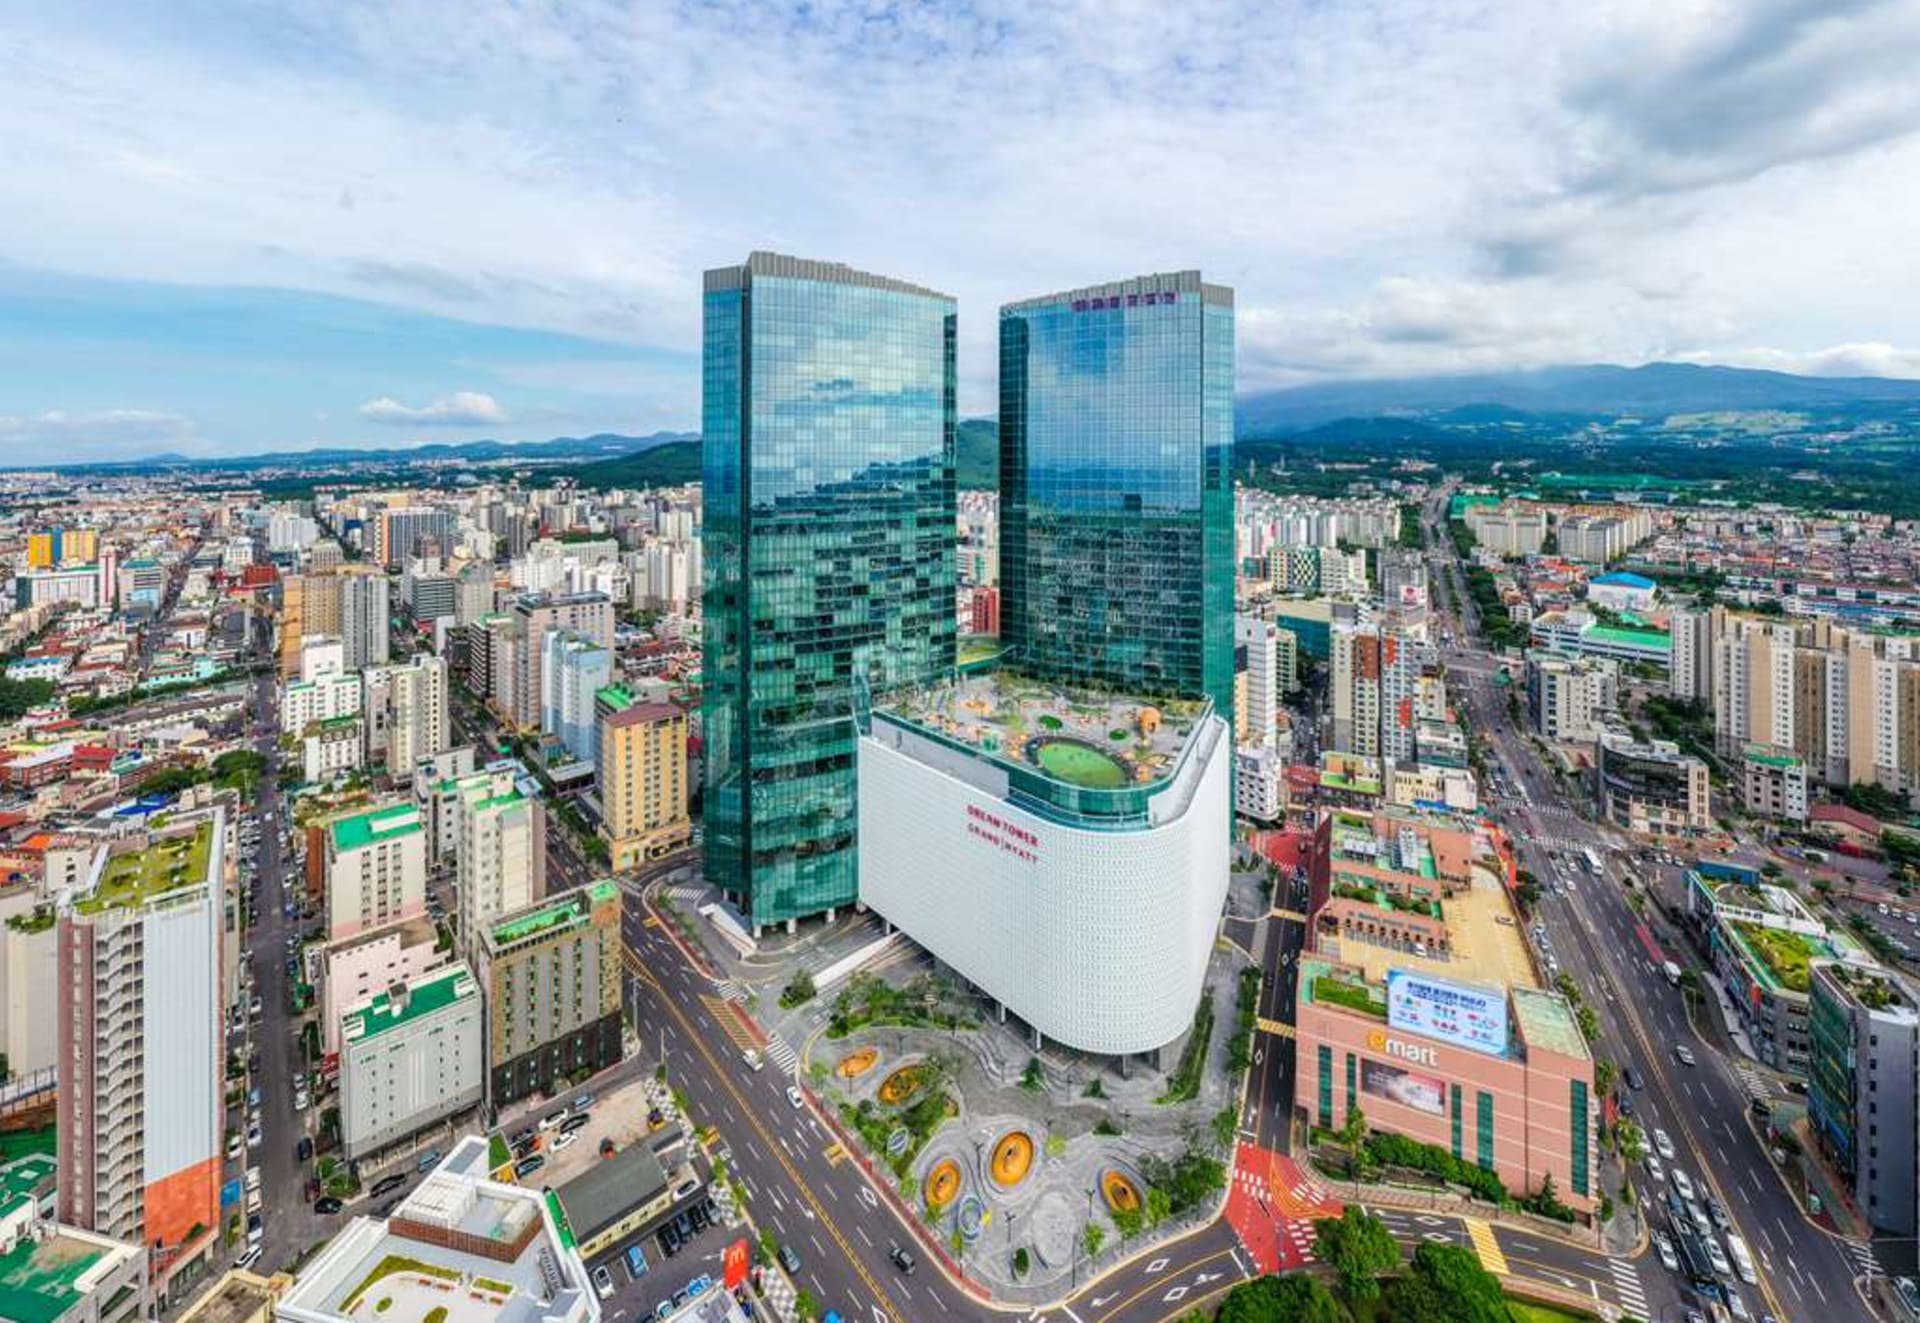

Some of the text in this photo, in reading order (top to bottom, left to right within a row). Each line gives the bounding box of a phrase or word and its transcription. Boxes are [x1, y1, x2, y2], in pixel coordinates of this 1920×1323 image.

[967, 804, 1039, 847] DREAM TOWER
[1367, 1028, 1438, 1067] emart
